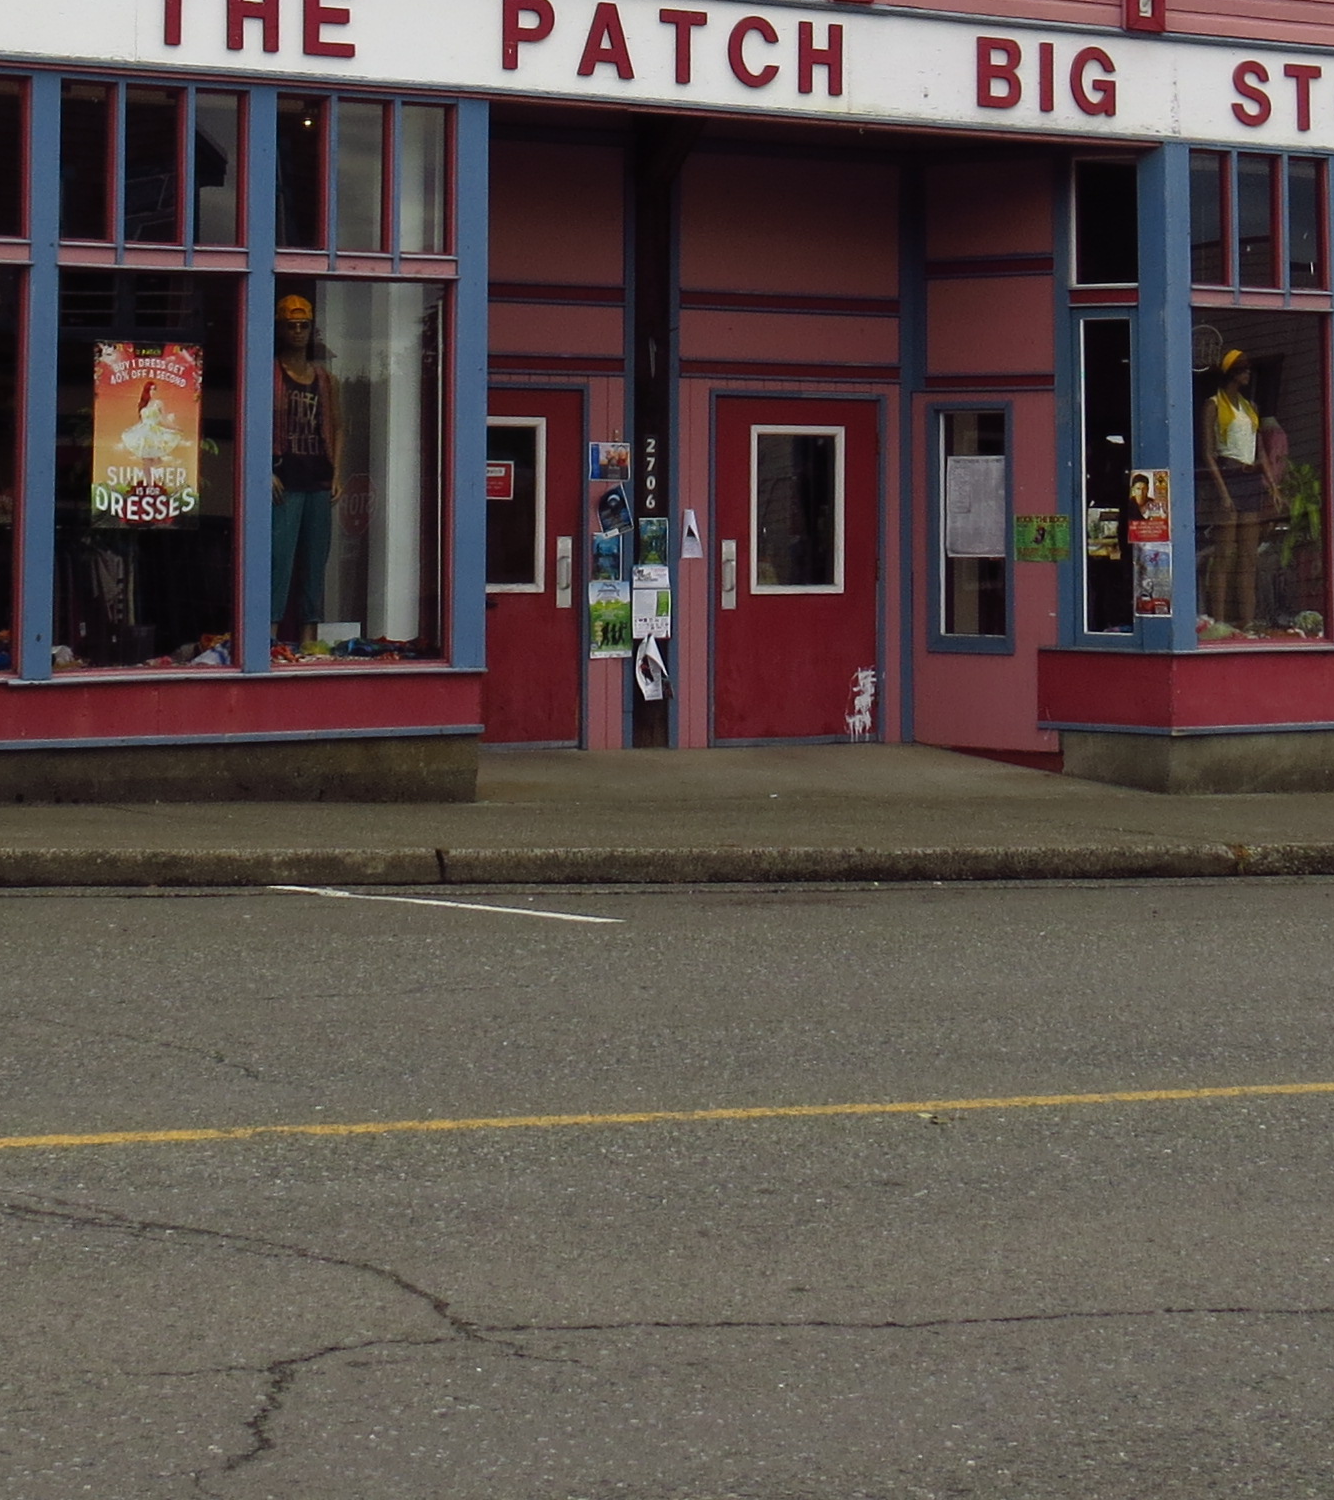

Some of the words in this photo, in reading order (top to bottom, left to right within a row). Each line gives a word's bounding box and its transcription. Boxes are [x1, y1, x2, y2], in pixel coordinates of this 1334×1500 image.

[976, 36, 1117, 117] BIG
[110, 371, 130, 385] 40%
[131, 369, 147, 379] OFF
[148, 369, 155, 378] A
[156, 370, 187, 388] SECOND
[139, 358, 165, 369] DRESS
[168, 362, 186, 375] GET
[107, 466, 186, 486] SUMMER
[645, 438, 656, 509] 2706
[95, 486, 195, 521] DRESSES
